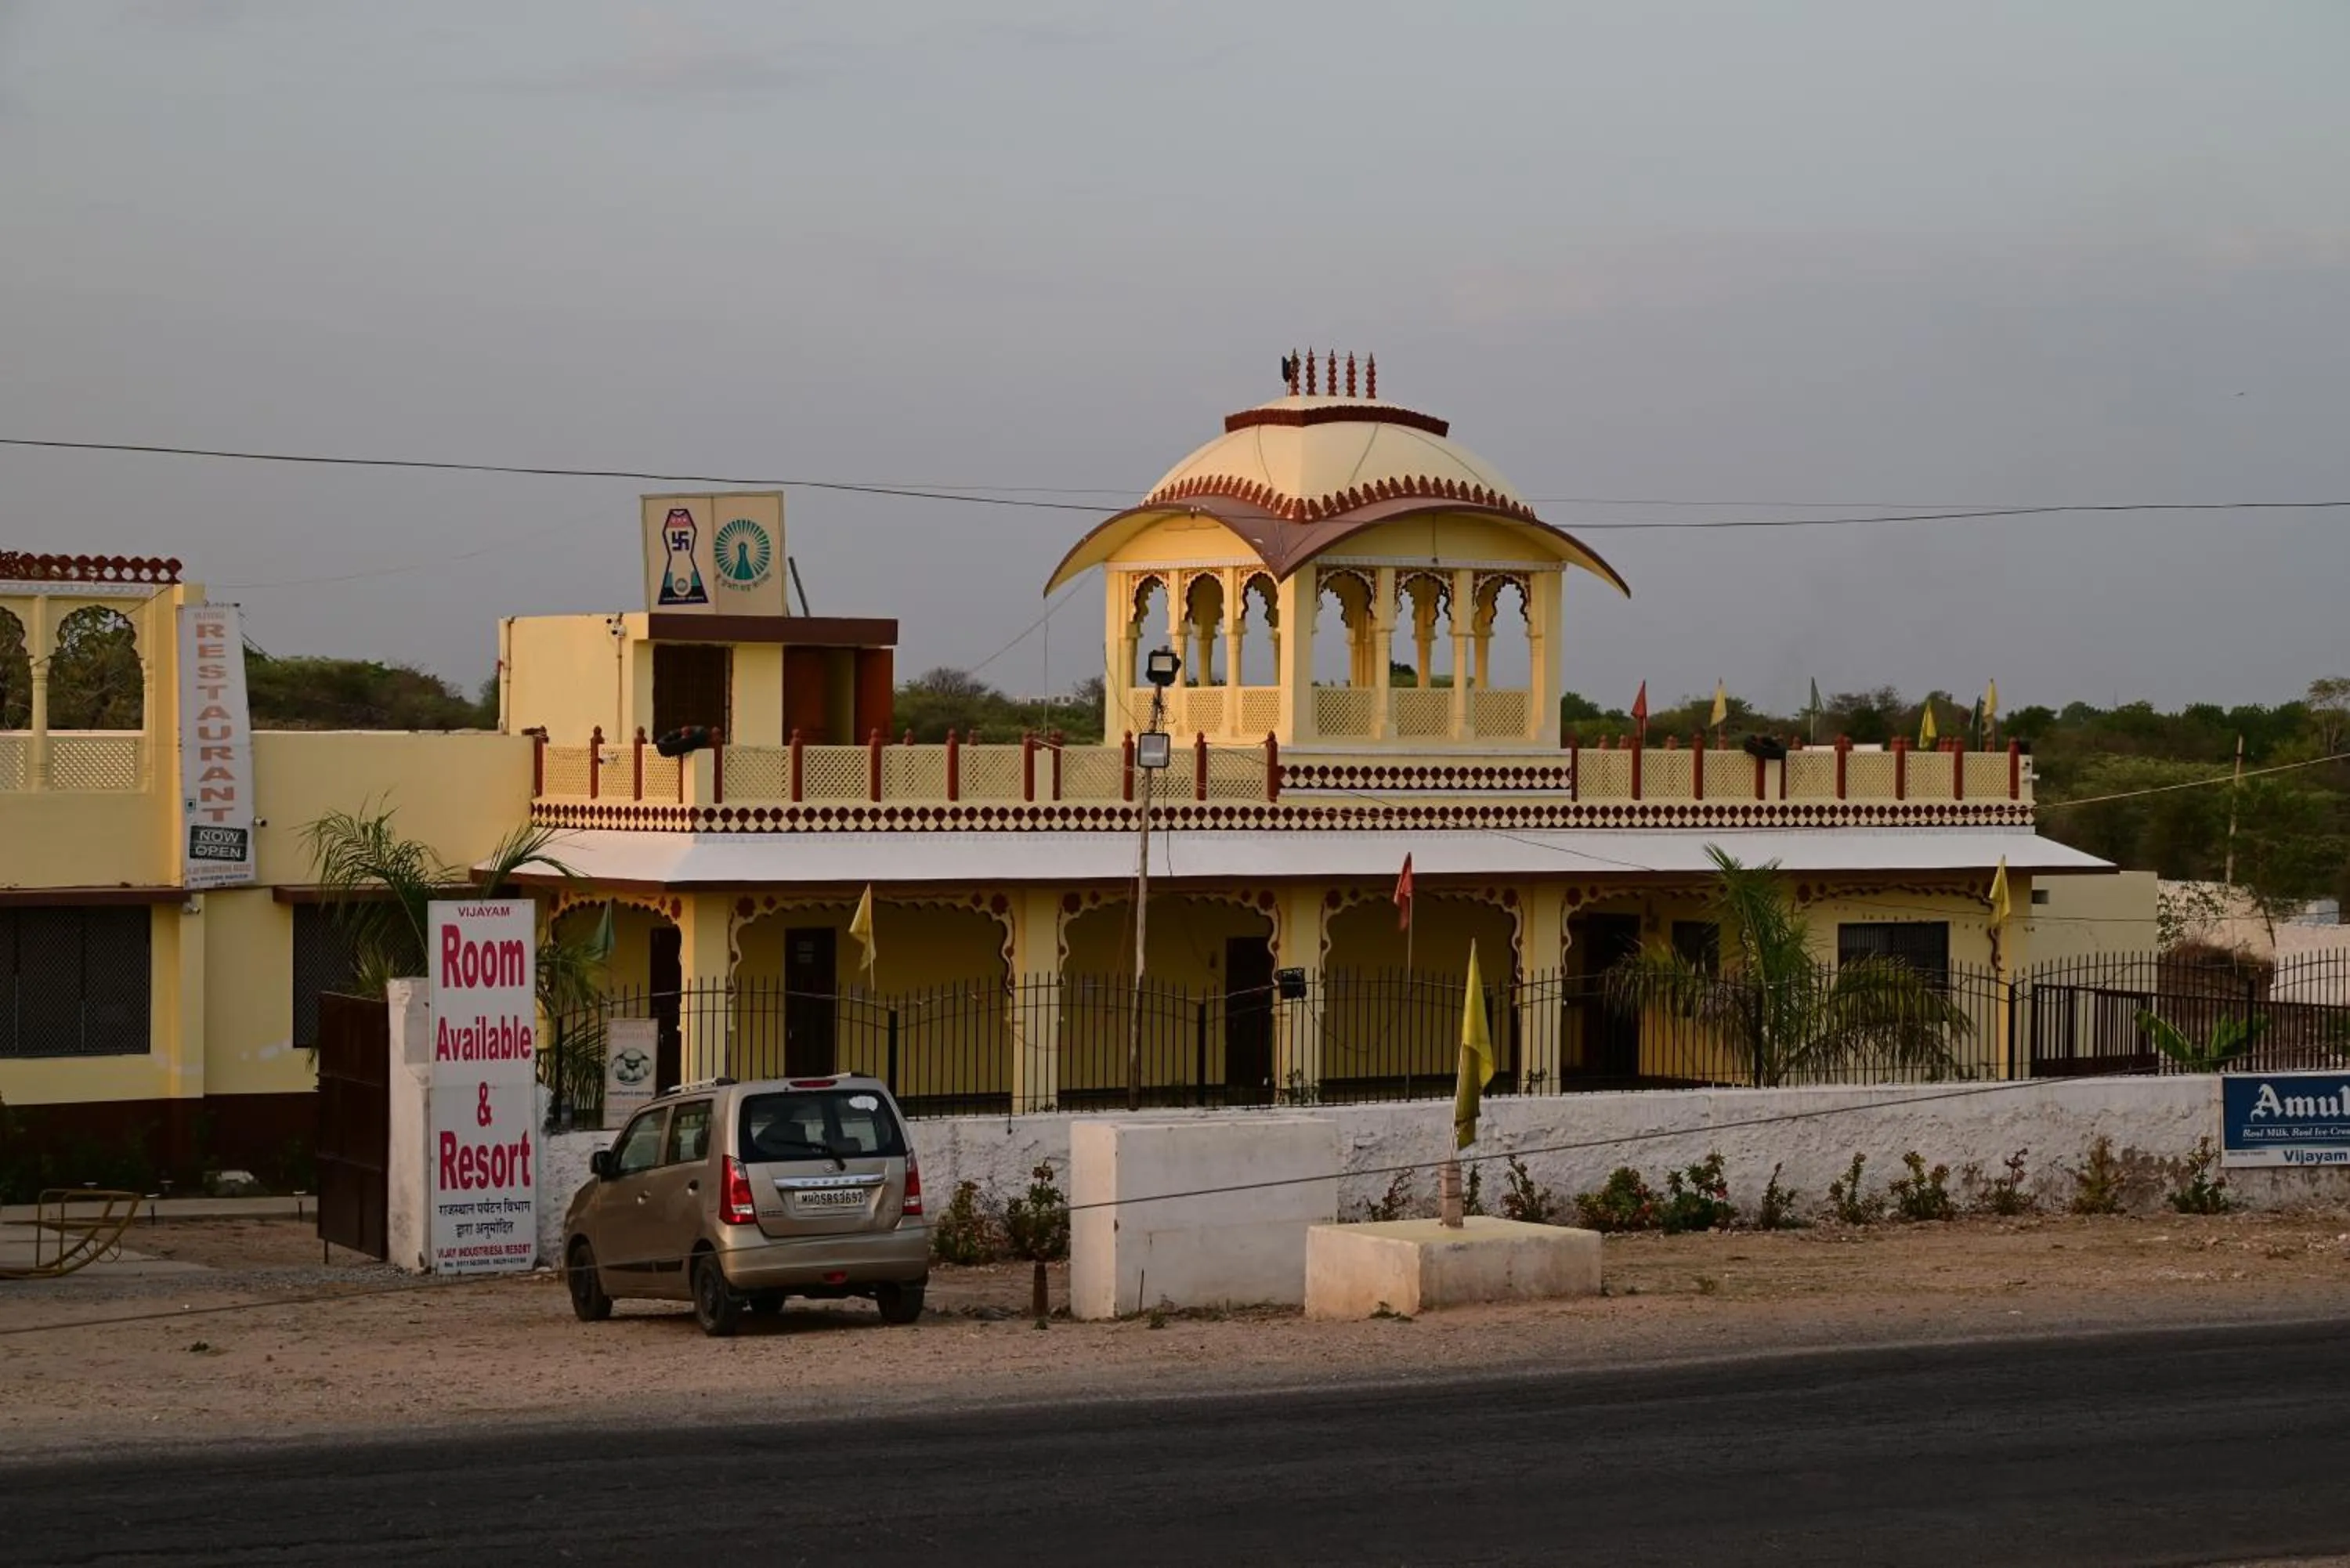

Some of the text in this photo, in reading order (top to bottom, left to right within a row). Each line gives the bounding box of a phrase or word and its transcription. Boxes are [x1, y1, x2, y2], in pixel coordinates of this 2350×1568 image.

[196, 623, 235, 822] RESTAURANT
[195, 845, 240, 858] OPEN
[200, 830, 239, 843] NOW
[457, 906, 510, 917] VIJAYAM
[441, 924, 525, 988] Room
[436, 1015, 531, 1060] Available
[477, 1082, 491, 1126] &
[2250, 1084, 2350, 1122] Amul
[439, 1129, 530, 1190] Resort
[2283, 1150, 2348, 1164] Vijayam
[503, 1198, 531, 1213] विभाग
